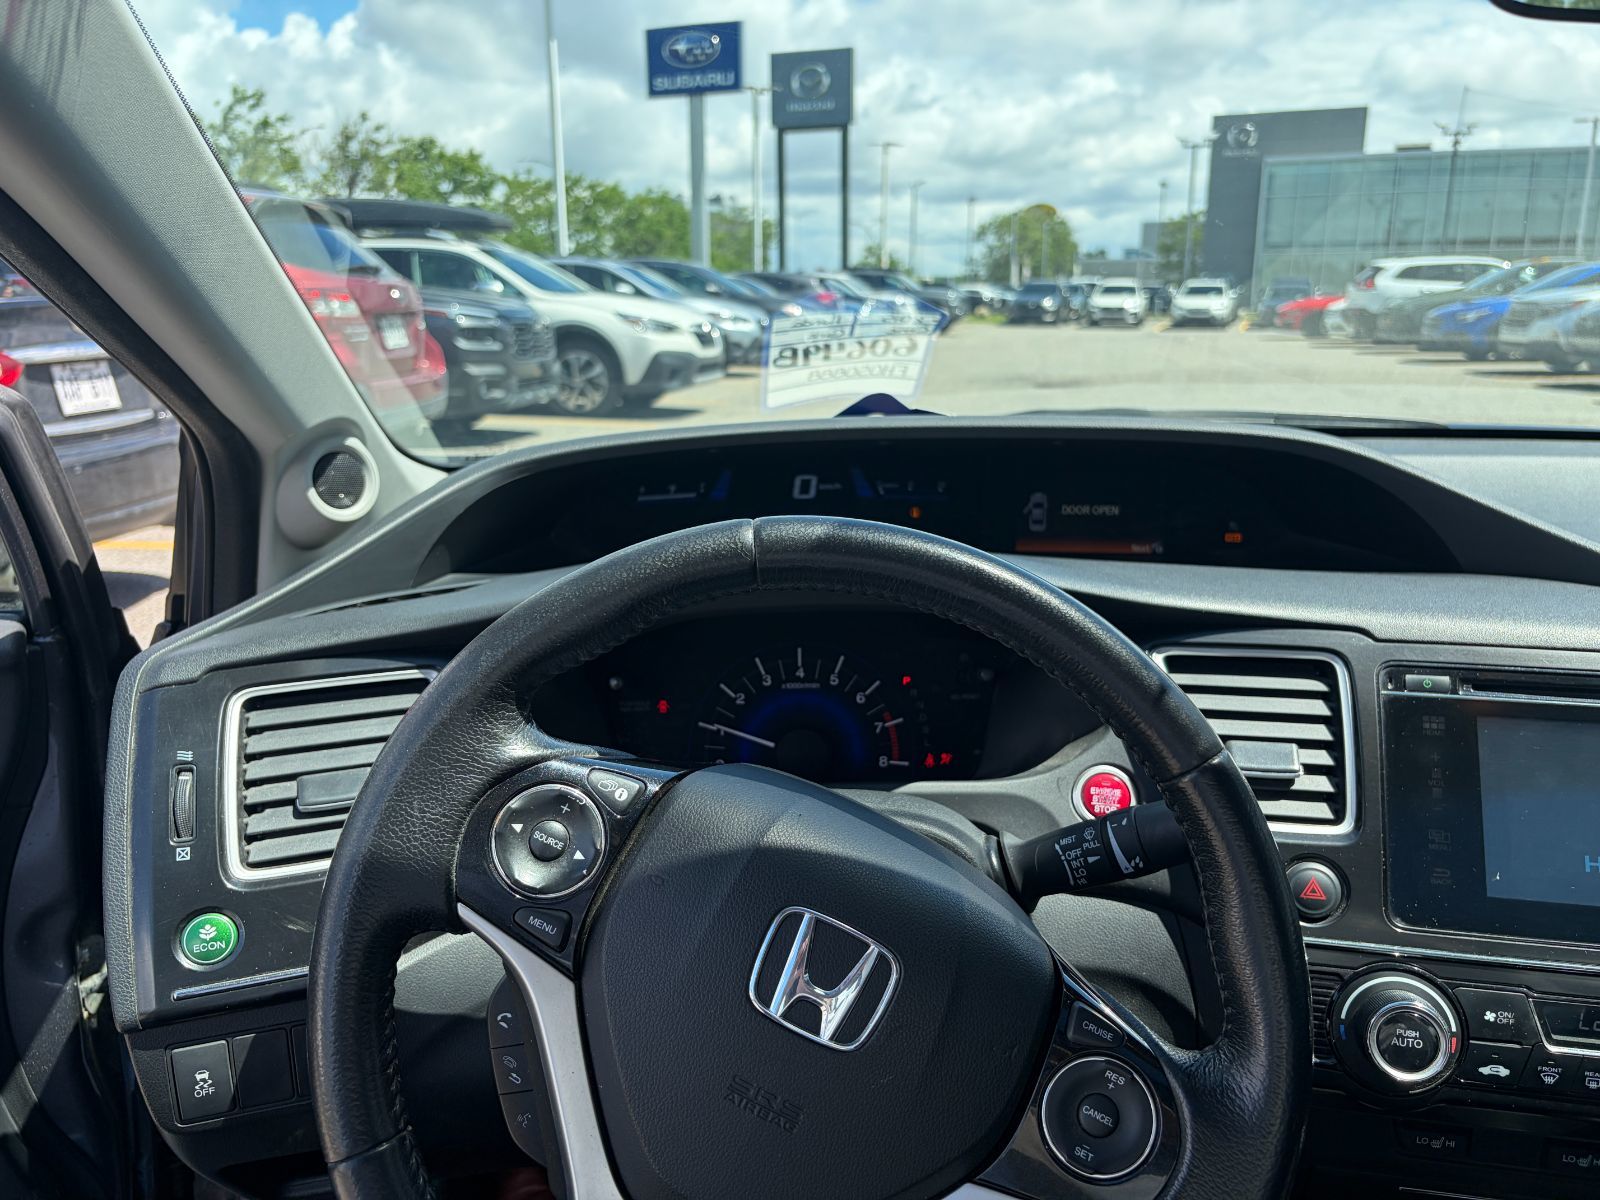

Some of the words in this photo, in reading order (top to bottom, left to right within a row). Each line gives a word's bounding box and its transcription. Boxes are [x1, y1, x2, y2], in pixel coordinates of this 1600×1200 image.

[652, 70, 735, 91] SUBARU
[1061, 504, 1090, 515] DOOR
[1091, 505, 1119, 516] OPEN
[795, 667, 805, 678] 4
[762, 674, 772, 685] 3
[829, 674, 839, 685] 5
[902, 675, 912, 686] P
[735, 693, 746, 705] 2
[856, 692, 866, 704] 6
[874, 722, 883, 734] 7
[879, 755, 888, 767] 8
[1090, 786, 1121, 797] ENGINE
[1094, 805, 1117, 813] STOP
[533, 830, 565, 851] SOURCE
[1059, 834, 1077, 845] MIST
[1083, 841, 1100, 850] PULL
[1066, 848, 1082, 860] OFF
[1071, 857, 1085, 868] INT
[1074, 869, 1087, 878] LO
[1077, 877, 1088, 886] HI
[528, 915, 557, 936] MENU
[193, 941, 226, 953] ECON
[1497, 1010, 1515, 1019] ON/
[1497, 1017, 1515, 1025] OFF
[1082, 1020, 1114, 1042] CRUISE
[1396, 1028, 1420, 1038] PUSH
[1391, 1037, 1423, 1049] AUTO
[1537, 1066, 1562, 1074] FRONT
[1104, 1069, 1125, 1085] RES
[194, 1086, 216, 1098] OFF
[1082, 1105, 1114, 1127] CANCEL
[1416, 1135, 1429, 1145] LO
[1445, 1140, 1456, 1149] HI
[1074, 1146, 1094, 1162] SET
[1562, 1154, 1576, 1163] LO
